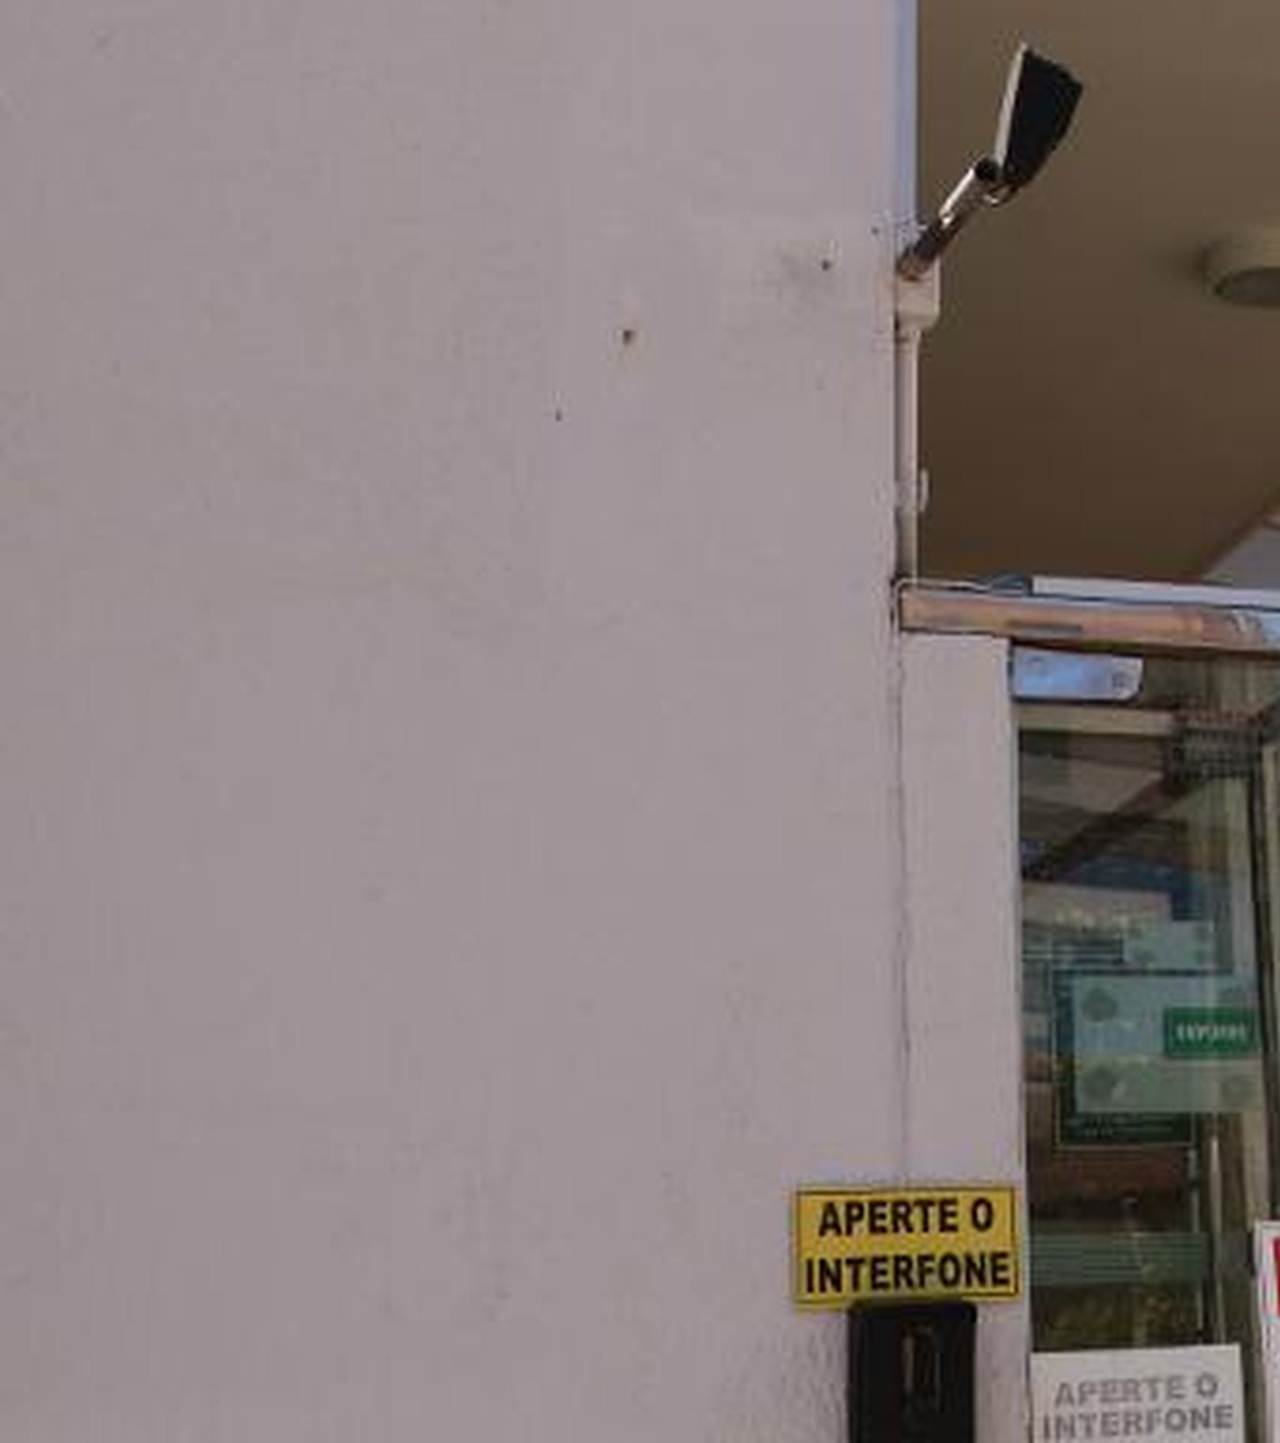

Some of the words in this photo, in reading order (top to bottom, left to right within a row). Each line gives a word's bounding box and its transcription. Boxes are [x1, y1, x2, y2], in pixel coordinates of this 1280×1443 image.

[818, 1199, 959, 1237] APERTE
[971, 1198, 994, 1231] O
[805, 1251, 1011, 1293] INTERFONE
[1054, 1375, 1185, 1407] APERTE
[1197, 1372, 1218, 1401] O
[1042, 1404, 1234, 1442] INTERFONE
